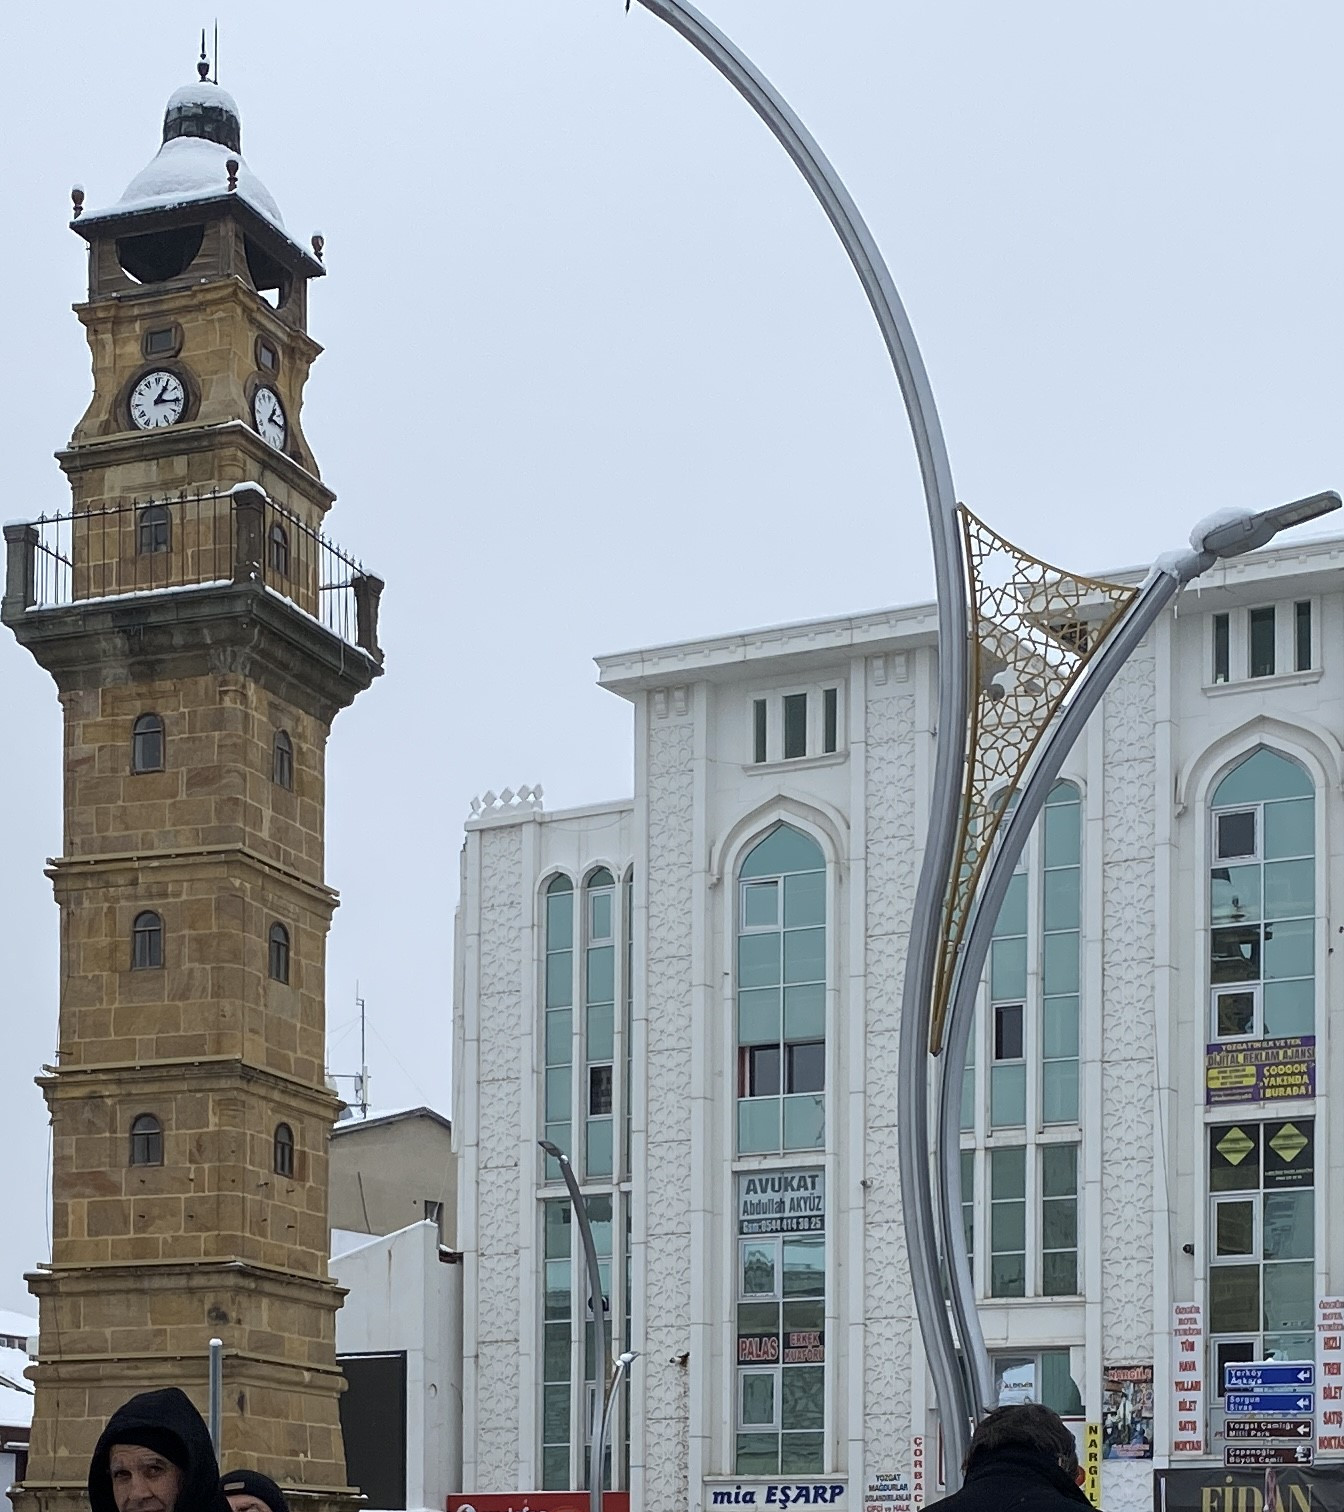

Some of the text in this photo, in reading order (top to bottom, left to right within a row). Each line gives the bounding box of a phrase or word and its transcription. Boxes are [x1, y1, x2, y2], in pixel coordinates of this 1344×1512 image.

[1243, 1049, 1280, 1065] REKLAM
[1262, 1075, 1310, 1087] YAKINDA
[1265, 1086, 1307, 1098] BURADA
[744, 1174, 819, 1195] AVUKAT
[742, 1192, 822, 1216] Abdullah AKYÜZ
[790, 1332, 821, 1347] ERKEK
[739, 1337, 779, 1361] PALAS
[1178, 1360, 1197, 1373] HAVA
[1322, 1383, 1344, 1401] BİLET
[1178, 1398, 1198, 1412] BİLET
[1322, 1411, 1344, 1429] SATIŞ
[1088, 1425, 1099, 1508] NARGİL
[712, 1485, 844, 1510] mia EŞARP
[893, 1504, 911, 1512] HALK
